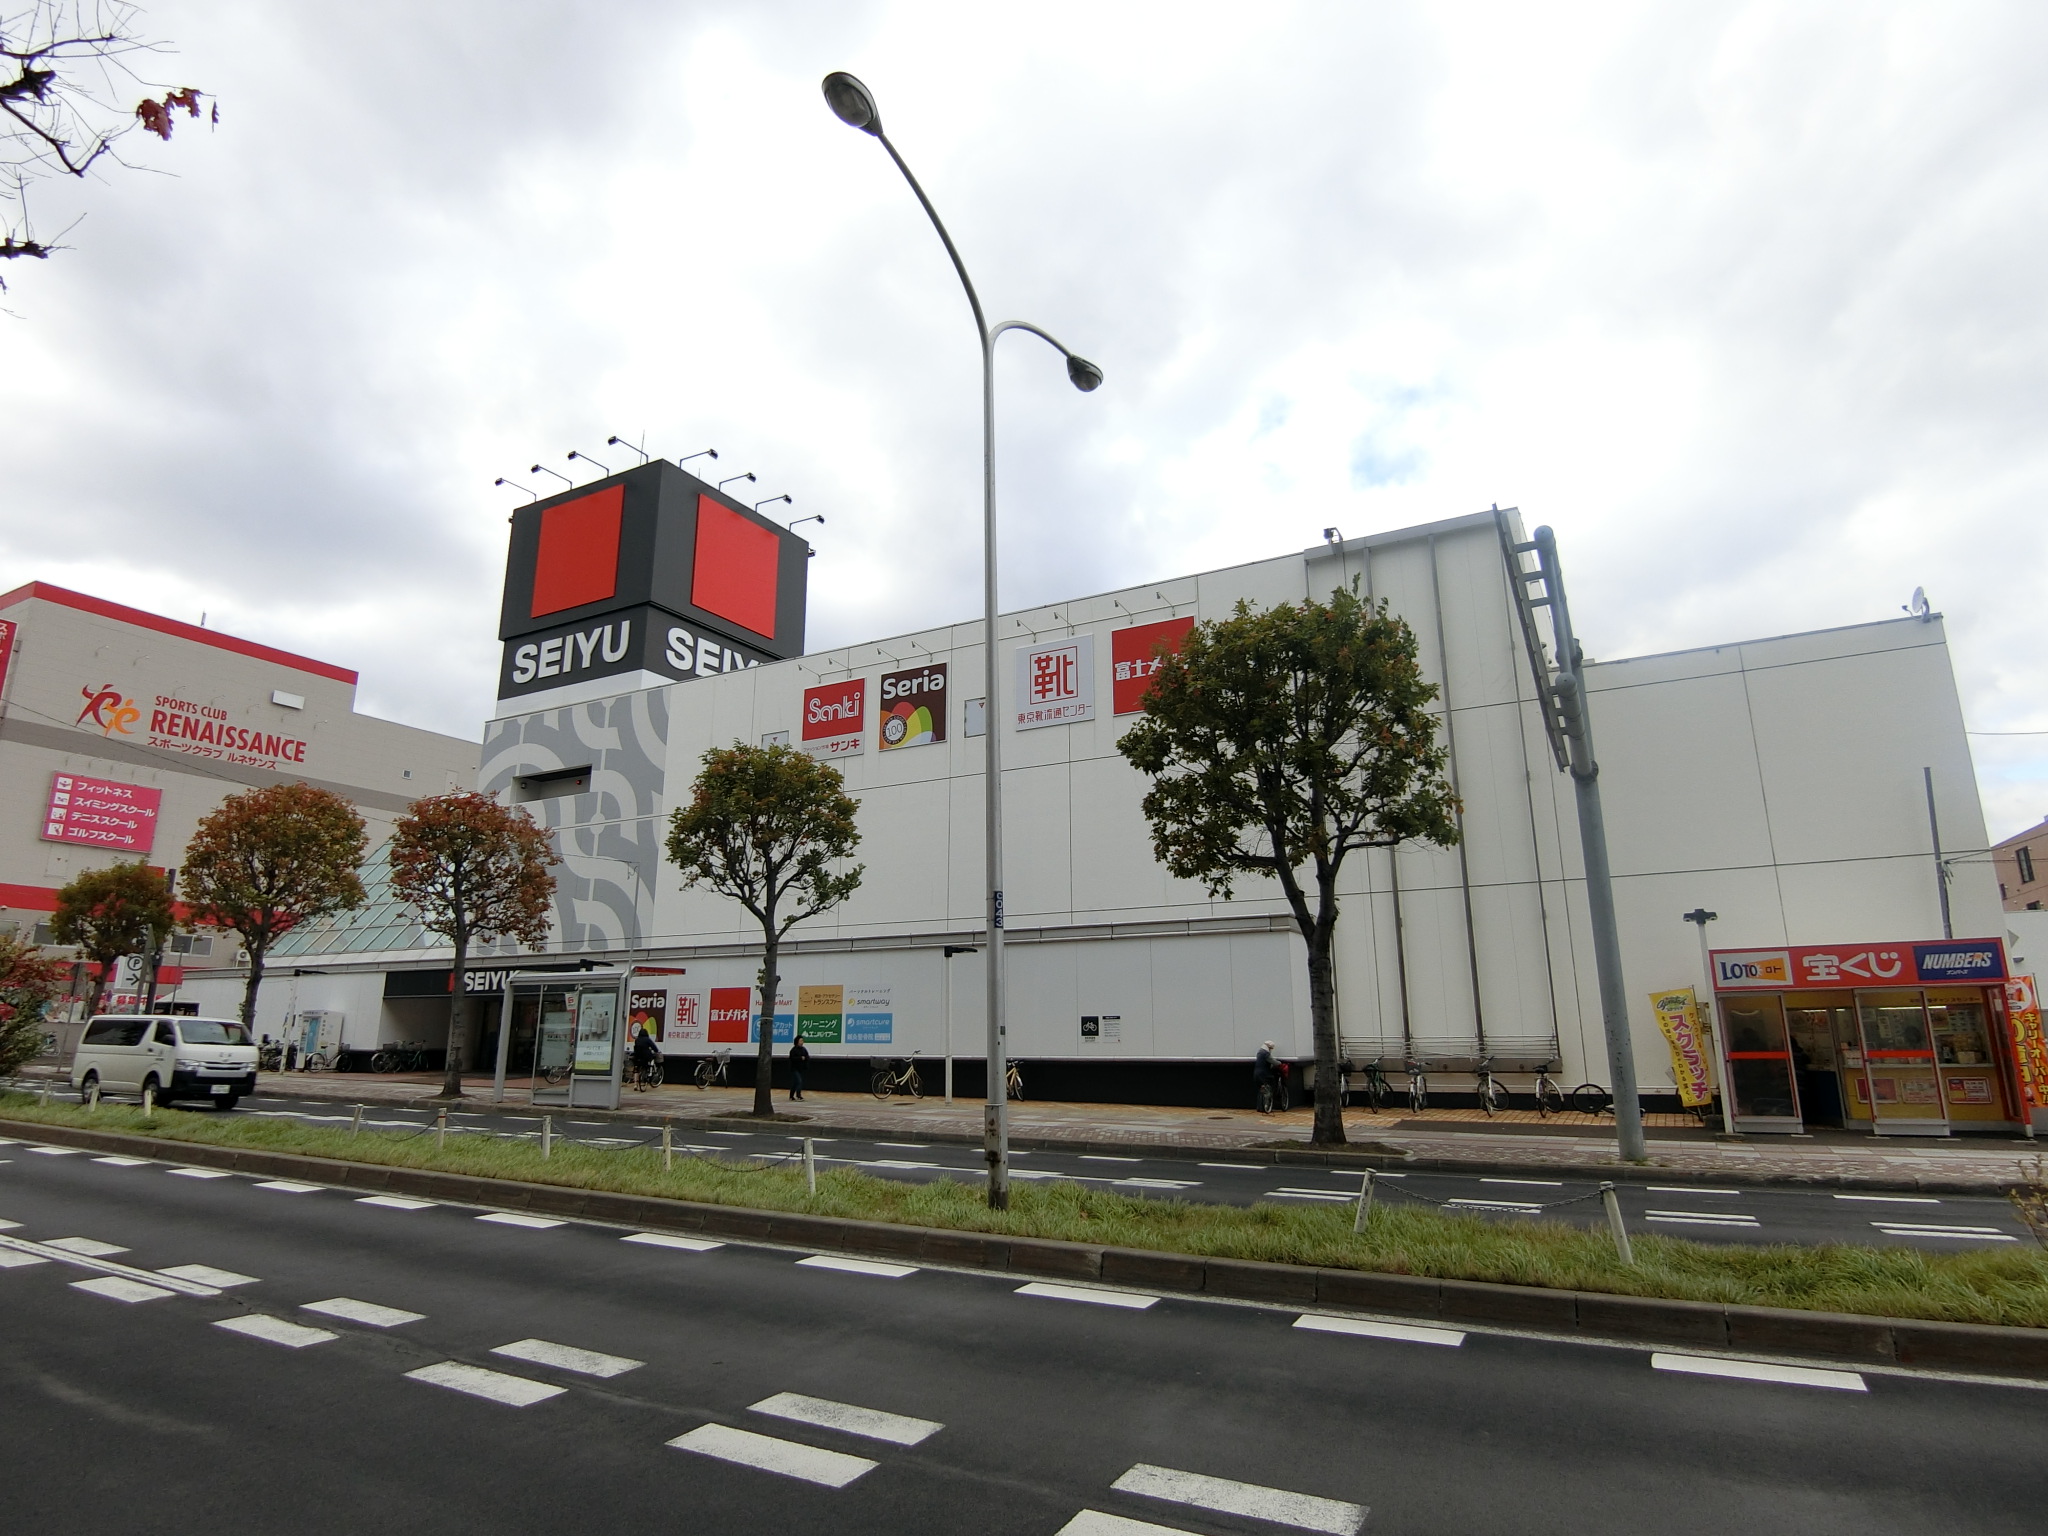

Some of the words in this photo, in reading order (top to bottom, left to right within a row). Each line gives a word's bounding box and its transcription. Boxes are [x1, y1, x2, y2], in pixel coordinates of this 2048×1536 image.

[512, 620, 631, 684] SEIYU
[883, 669, 945, 700] Seria
[1034, 654, 1075, 700] 靴
[155, 695, 198, 715] SPORTS
[201, 706, 228, 721] CLUB
[808, 691, 861, 724] Sanki
[1018, 704, 1092, 725] 東京靴流通センター
[150, 709, 307, 763] RENAISSANCE
[887, 722, 903, 737] 100
[147, 736, 224, 759] スポーツクラブ
[227, 752, 277, 770] ルネサンス
[830, 738, 861, 753] サンキ
[77, 782, 133, 799] フィットネス
[74, 797, 155, 817] スイミングスクール
[71, 812, 138, 829] テニススクール
[67, 827, 135, 844] ゴルフスクール
[1720, 961, 1757, 980] LOTO
[1802, 951, 1902, 981] 宝くじ
[1922, 952, 1992, 970] NUMBERS
[631, 993, 666, 1009] Seria
[677, 996, 698, 1025] 靴
[857, 998, 890, 1006] smartway
[711, 1009, 748, 1021] 富士メガネ
[802, 1019, 837, 1029] クリーニング
[1669, 1014, 1708, 1100] スクラッチ
